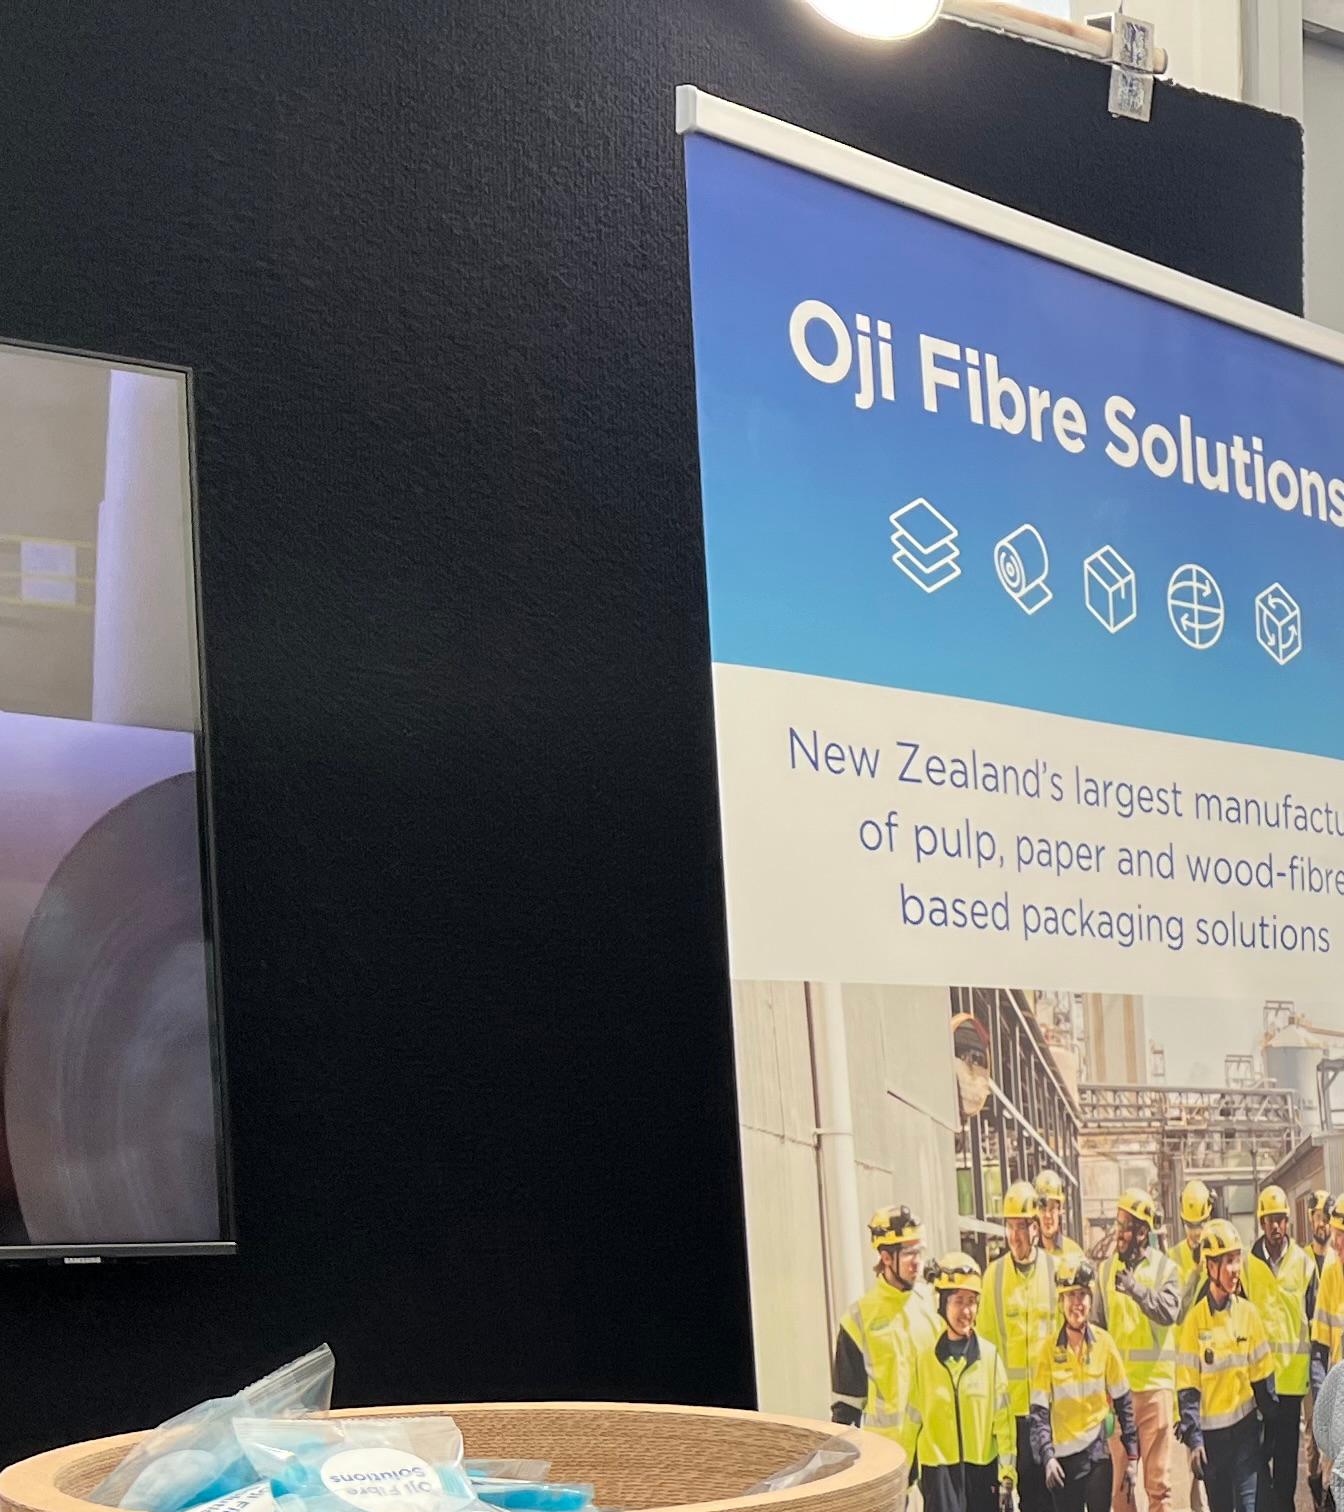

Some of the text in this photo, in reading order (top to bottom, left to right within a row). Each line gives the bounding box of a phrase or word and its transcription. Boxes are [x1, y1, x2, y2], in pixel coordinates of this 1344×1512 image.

[789, 299, 896, 409] Oji
[921, 331, 1087, 454] Fibre
[788, 726, 880, 780] New
[1075, 764, 1182, 821] largest
[858, 811, 897, 854] of
[916, 818, 1005, 871] pulp,
[1016, 834, 1106, 879] paper
[1117, 836, 1175, 880] and
[900, 884, 1332, 954] based packaging solutions
[330, 1466, 426, 1483] Solutions
